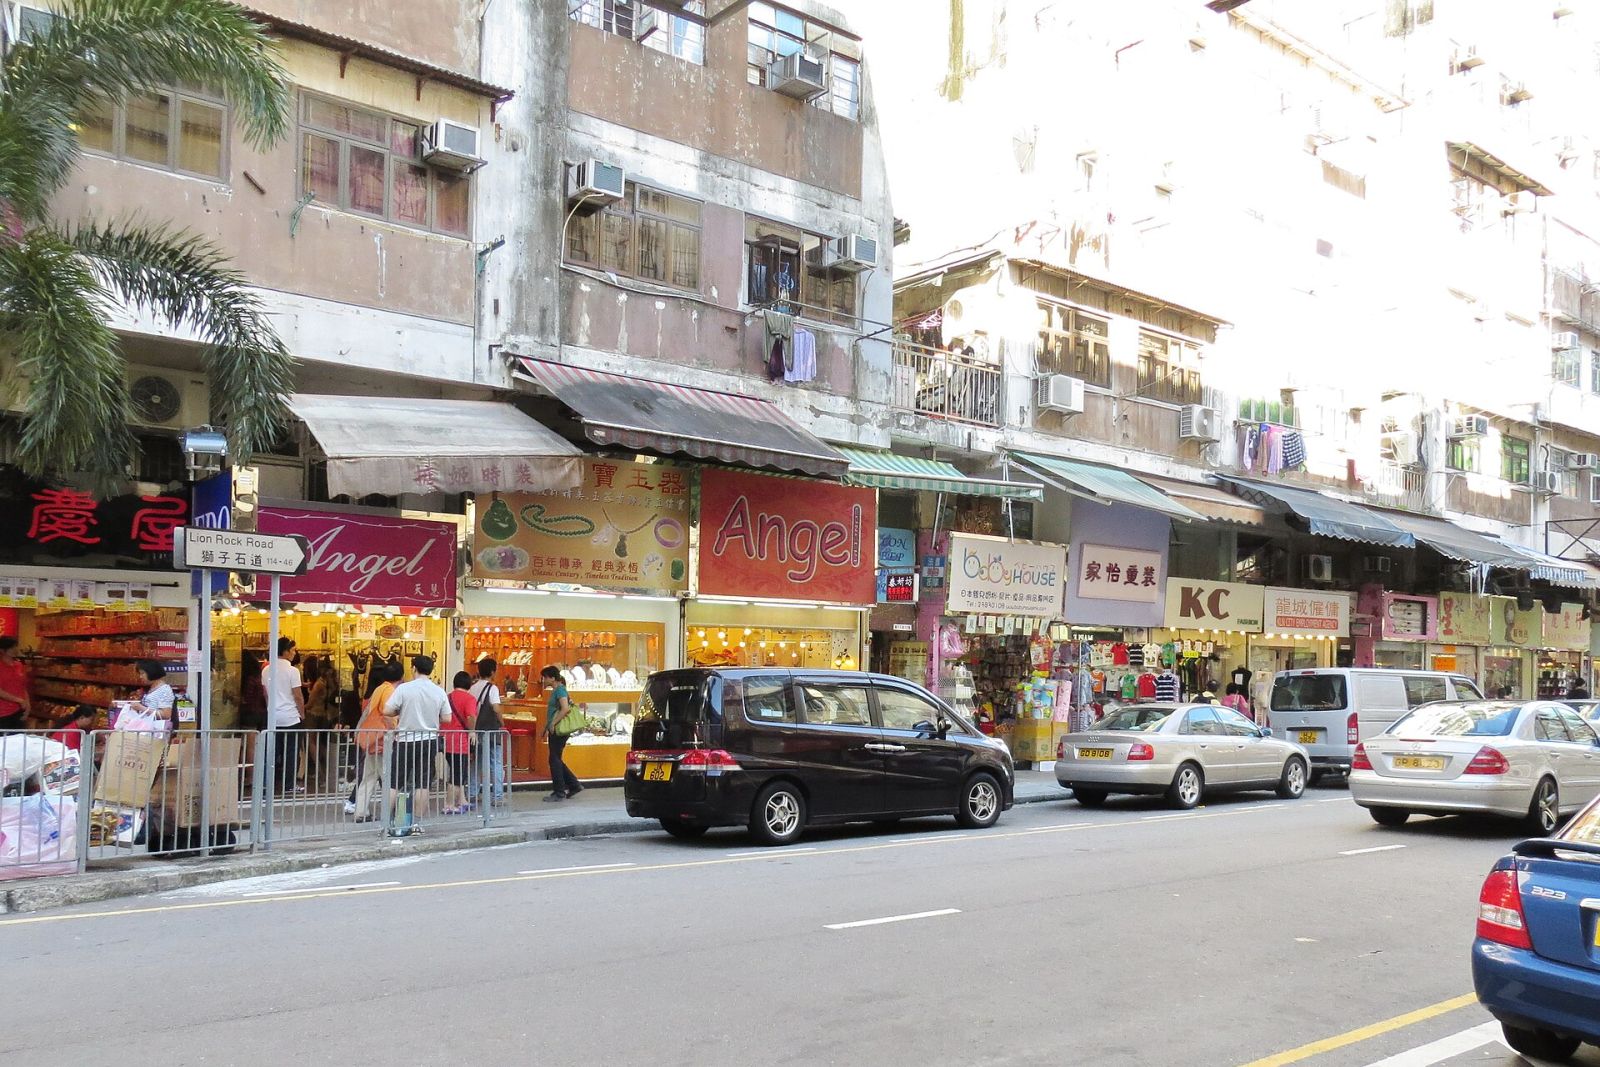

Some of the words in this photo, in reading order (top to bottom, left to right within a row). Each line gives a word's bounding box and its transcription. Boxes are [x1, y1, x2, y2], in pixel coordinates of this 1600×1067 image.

[189, 531, 213, 544] Lion
[215, 534, 243, 547] Rock
[245, 536, 274, 549] Road
[713, 495, 862, 583] Angel
[201, 550, 263, 567] 獅子石道
[297, 525, 436, 593] Angel
[1012, 568, 1056, 587] HOUSE
[1179, 586, 1231, 621] KC
[1531, 885, 1567, 900] 323
